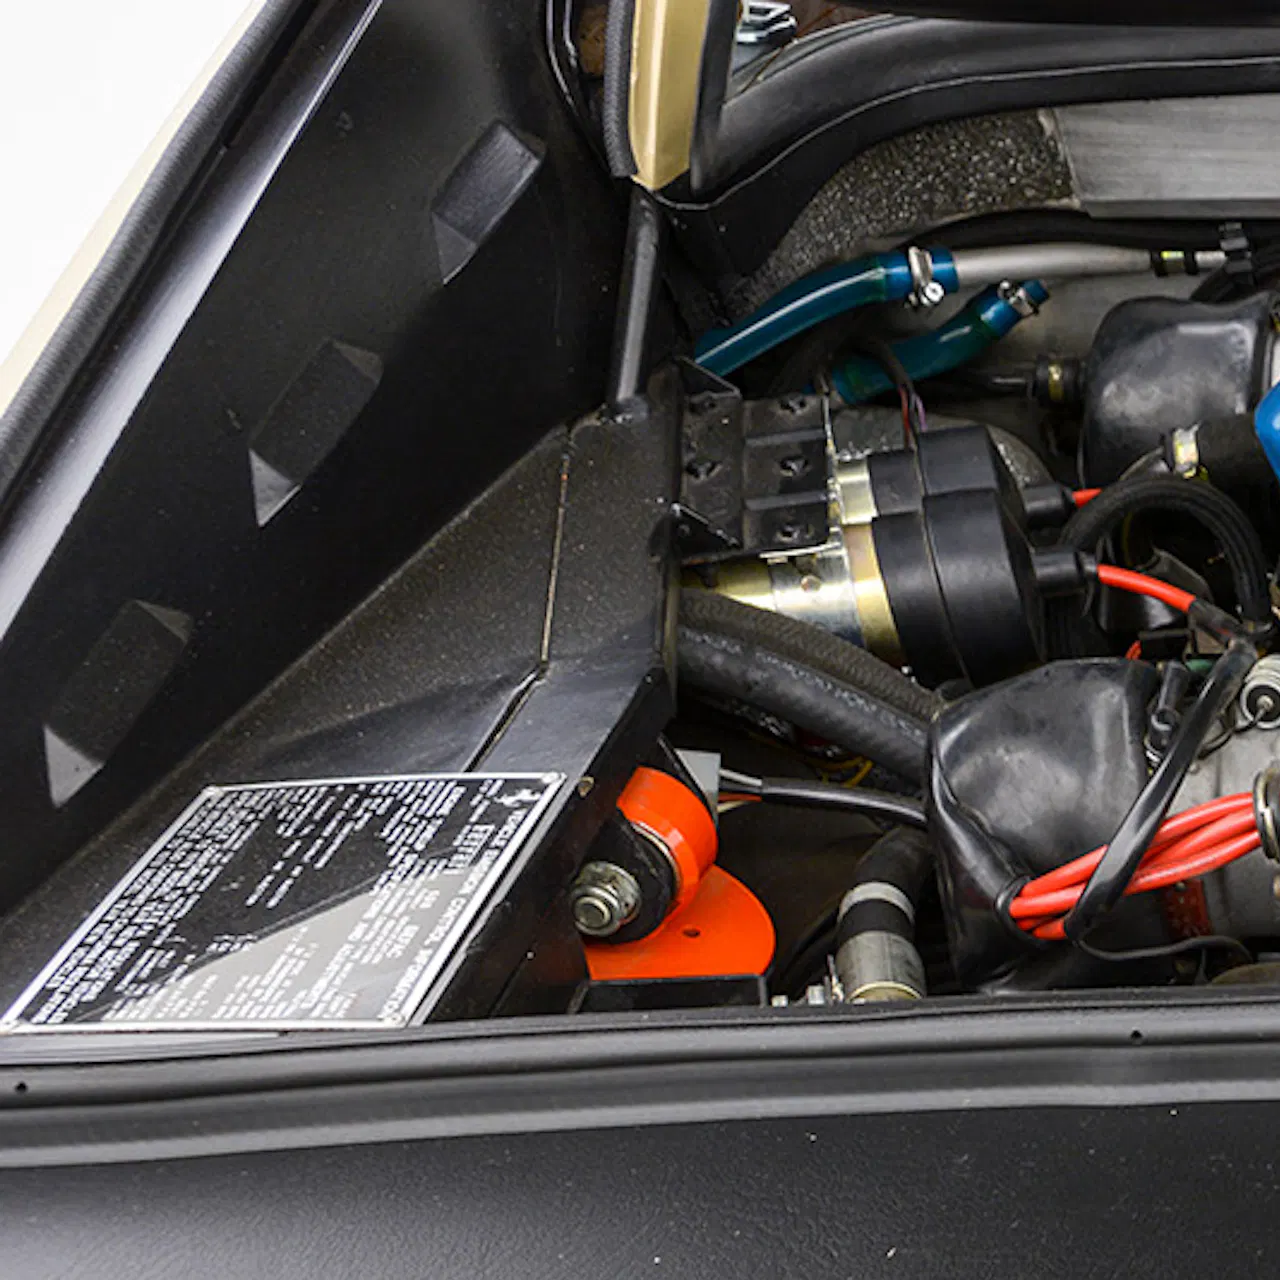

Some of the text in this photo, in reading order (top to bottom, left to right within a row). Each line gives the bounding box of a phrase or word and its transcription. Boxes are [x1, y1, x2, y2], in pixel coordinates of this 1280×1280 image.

[440, 825, 494, 874] Ferrari
[491, 809, 526, 846] VEHICLE
[425, 898, 465, 944] CONTROL
[379, 950, 432, 1017] INFORMATION
